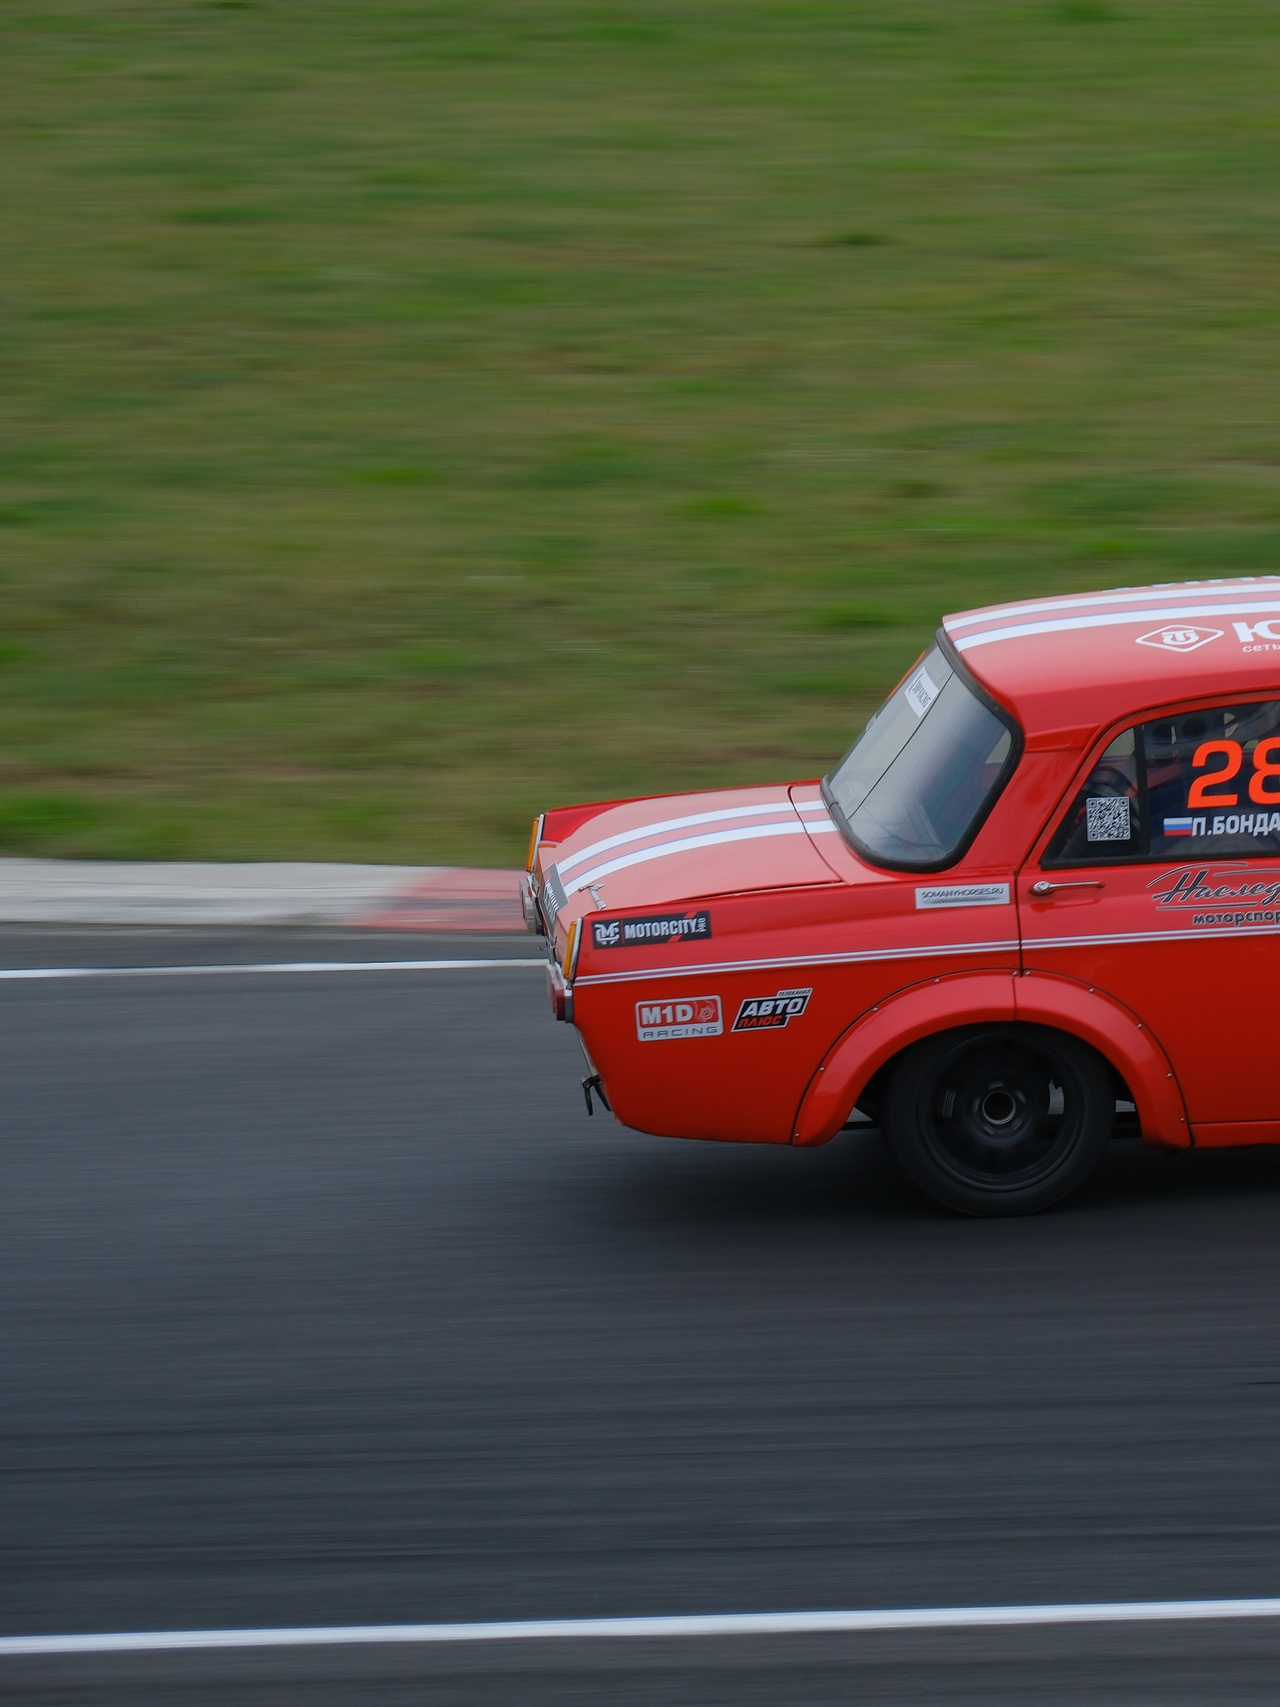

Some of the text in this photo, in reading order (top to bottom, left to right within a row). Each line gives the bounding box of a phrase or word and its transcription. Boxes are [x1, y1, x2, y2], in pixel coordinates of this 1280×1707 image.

[641, 1004, 694, 1025] M1D
[741, 997, 804, 1017] АВТО
[736, 1015, 783, 1029] ПЛЮС
[643, 1026, 718, 1038] RACING
